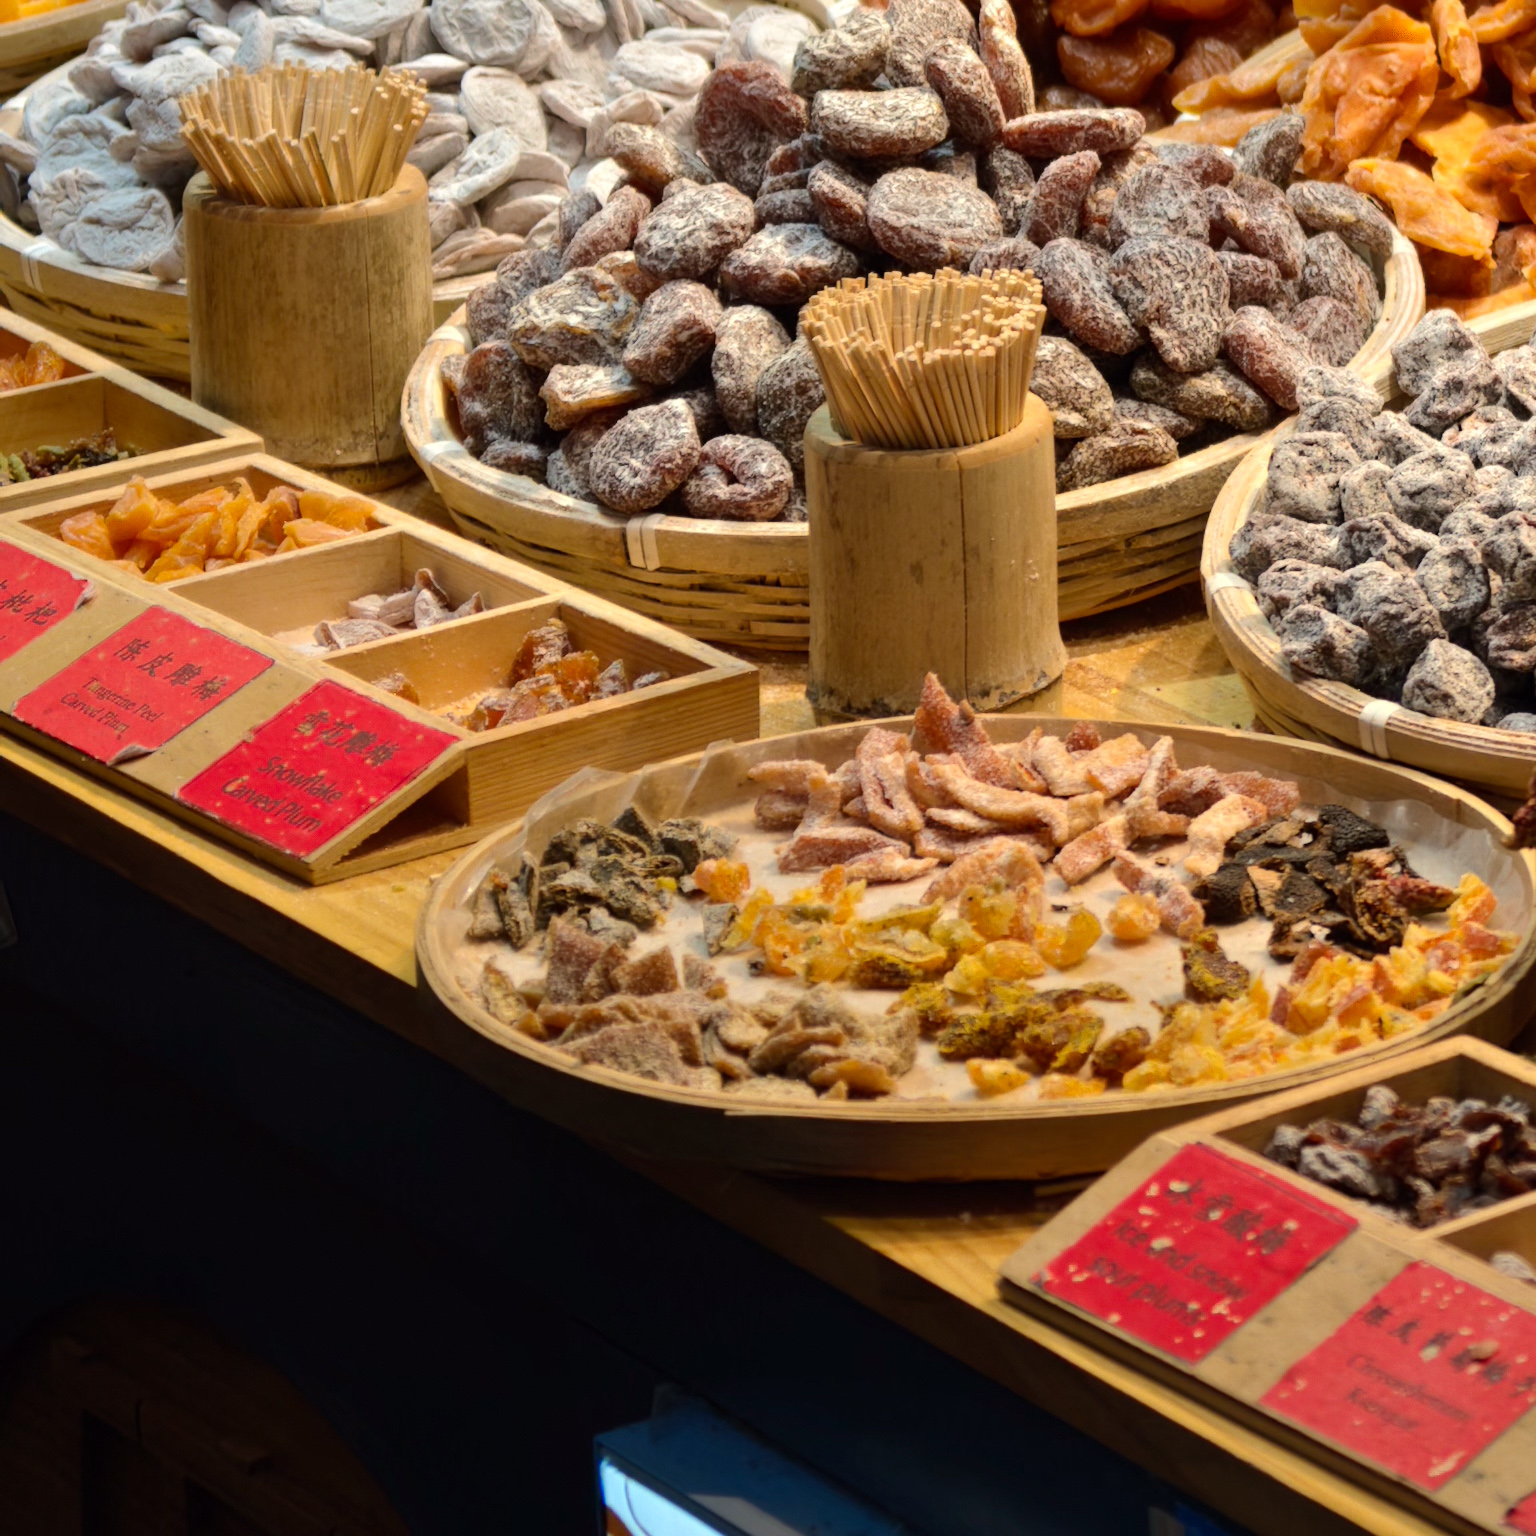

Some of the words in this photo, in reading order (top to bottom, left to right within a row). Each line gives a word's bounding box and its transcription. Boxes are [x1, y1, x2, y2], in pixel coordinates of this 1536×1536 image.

[60, 692, 107, 723] Carved
[135, 701, 166, 723] Peel
[258, 755, 344, 805] Snowflake
[221, 775, 284, 815] Carved
[276, 801, 323, 833] Plum
